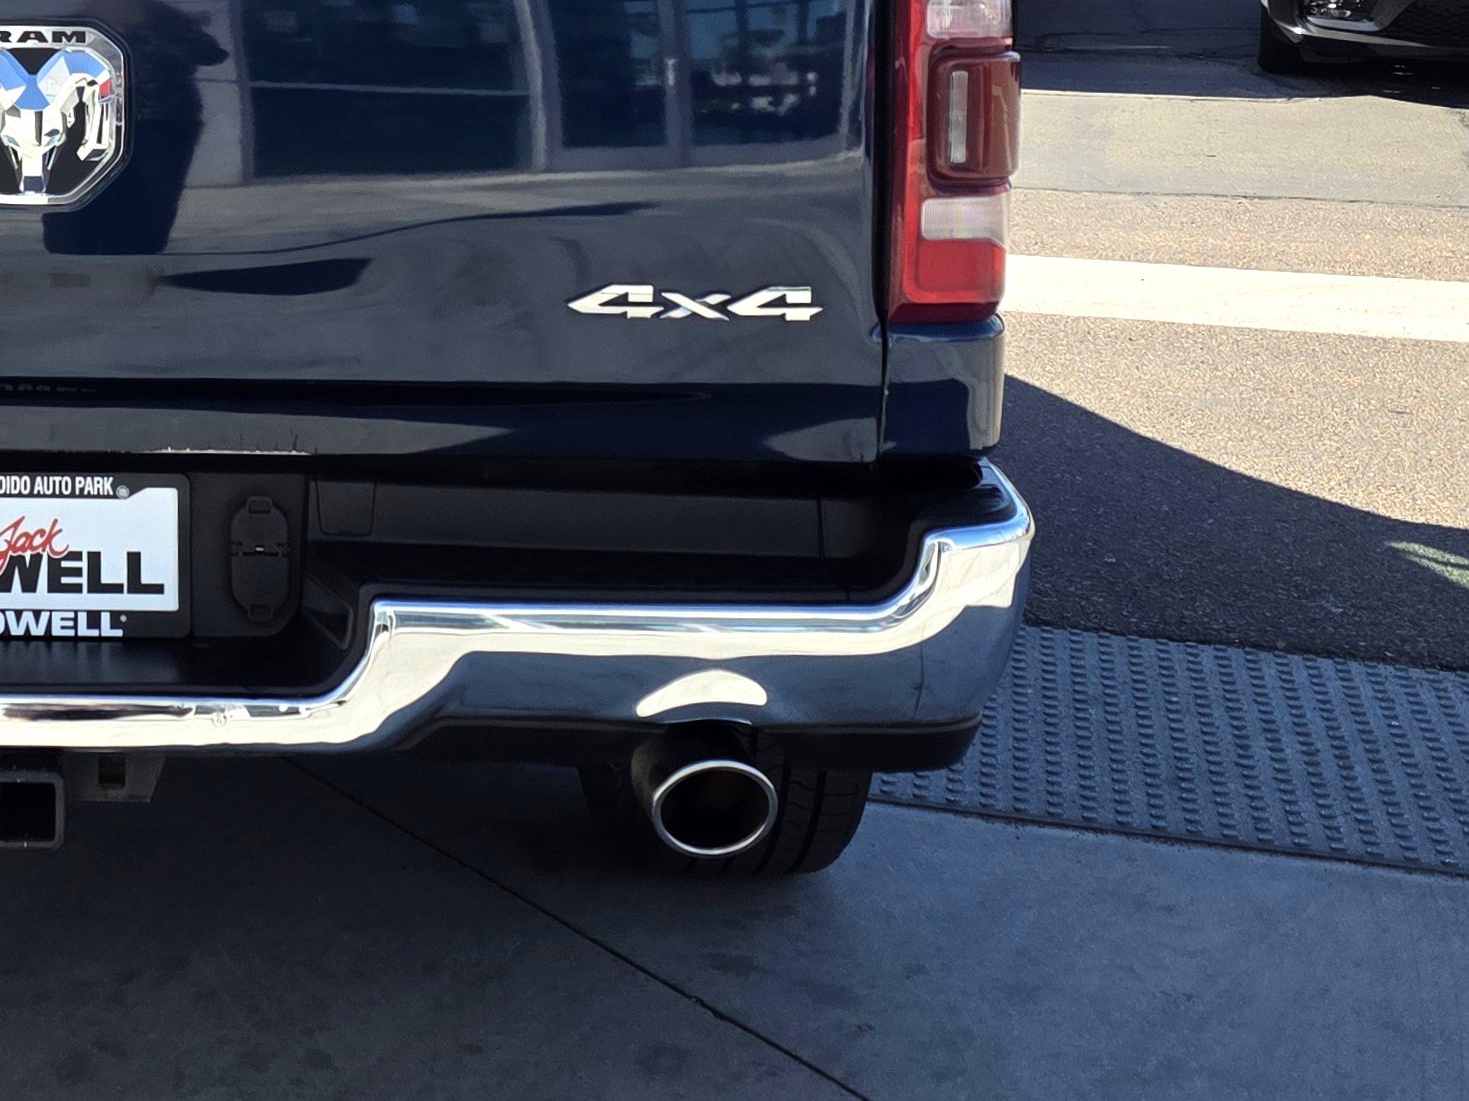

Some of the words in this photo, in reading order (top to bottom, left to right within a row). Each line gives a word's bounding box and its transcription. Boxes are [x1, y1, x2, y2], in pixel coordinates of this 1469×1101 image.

[567, 284, 823, 322] 4x4
[34, 475, 72, 496] AUTO
[75, 476, 114, 496] PARK
